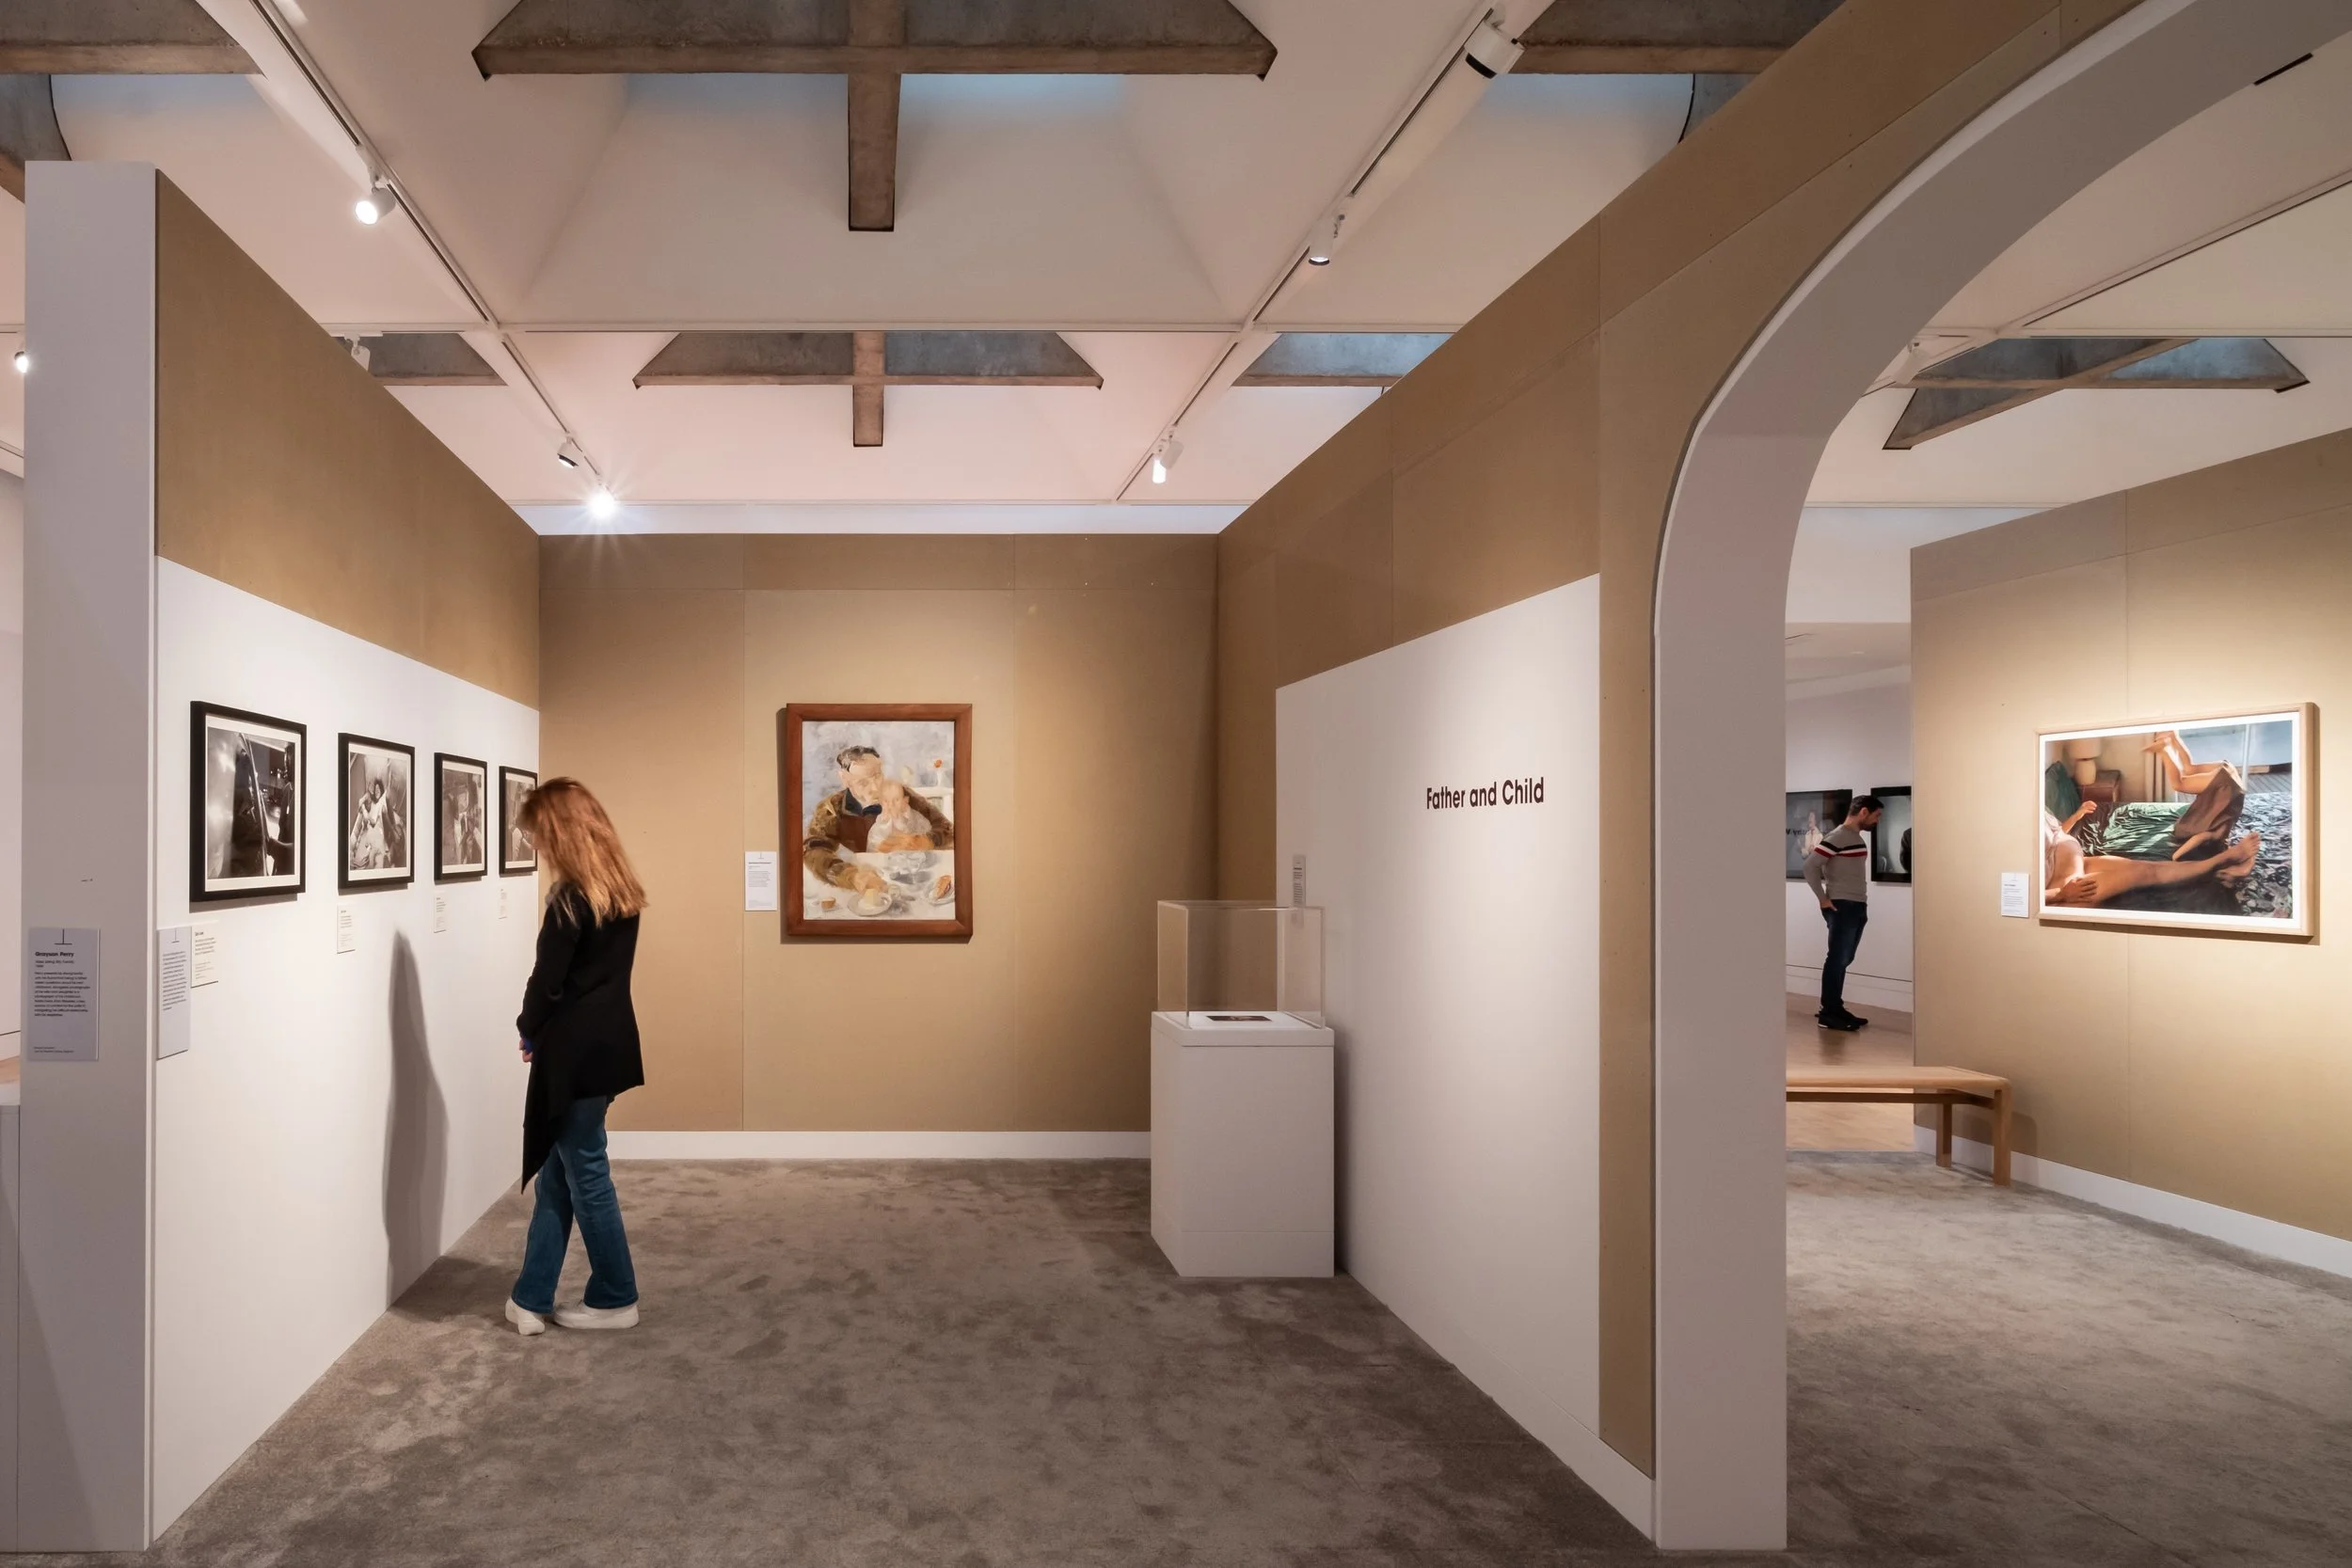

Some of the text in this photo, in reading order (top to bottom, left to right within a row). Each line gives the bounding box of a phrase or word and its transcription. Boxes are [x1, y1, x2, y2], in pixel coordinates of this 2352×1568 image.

[1426, 776, 1545, 810] Father and Child
